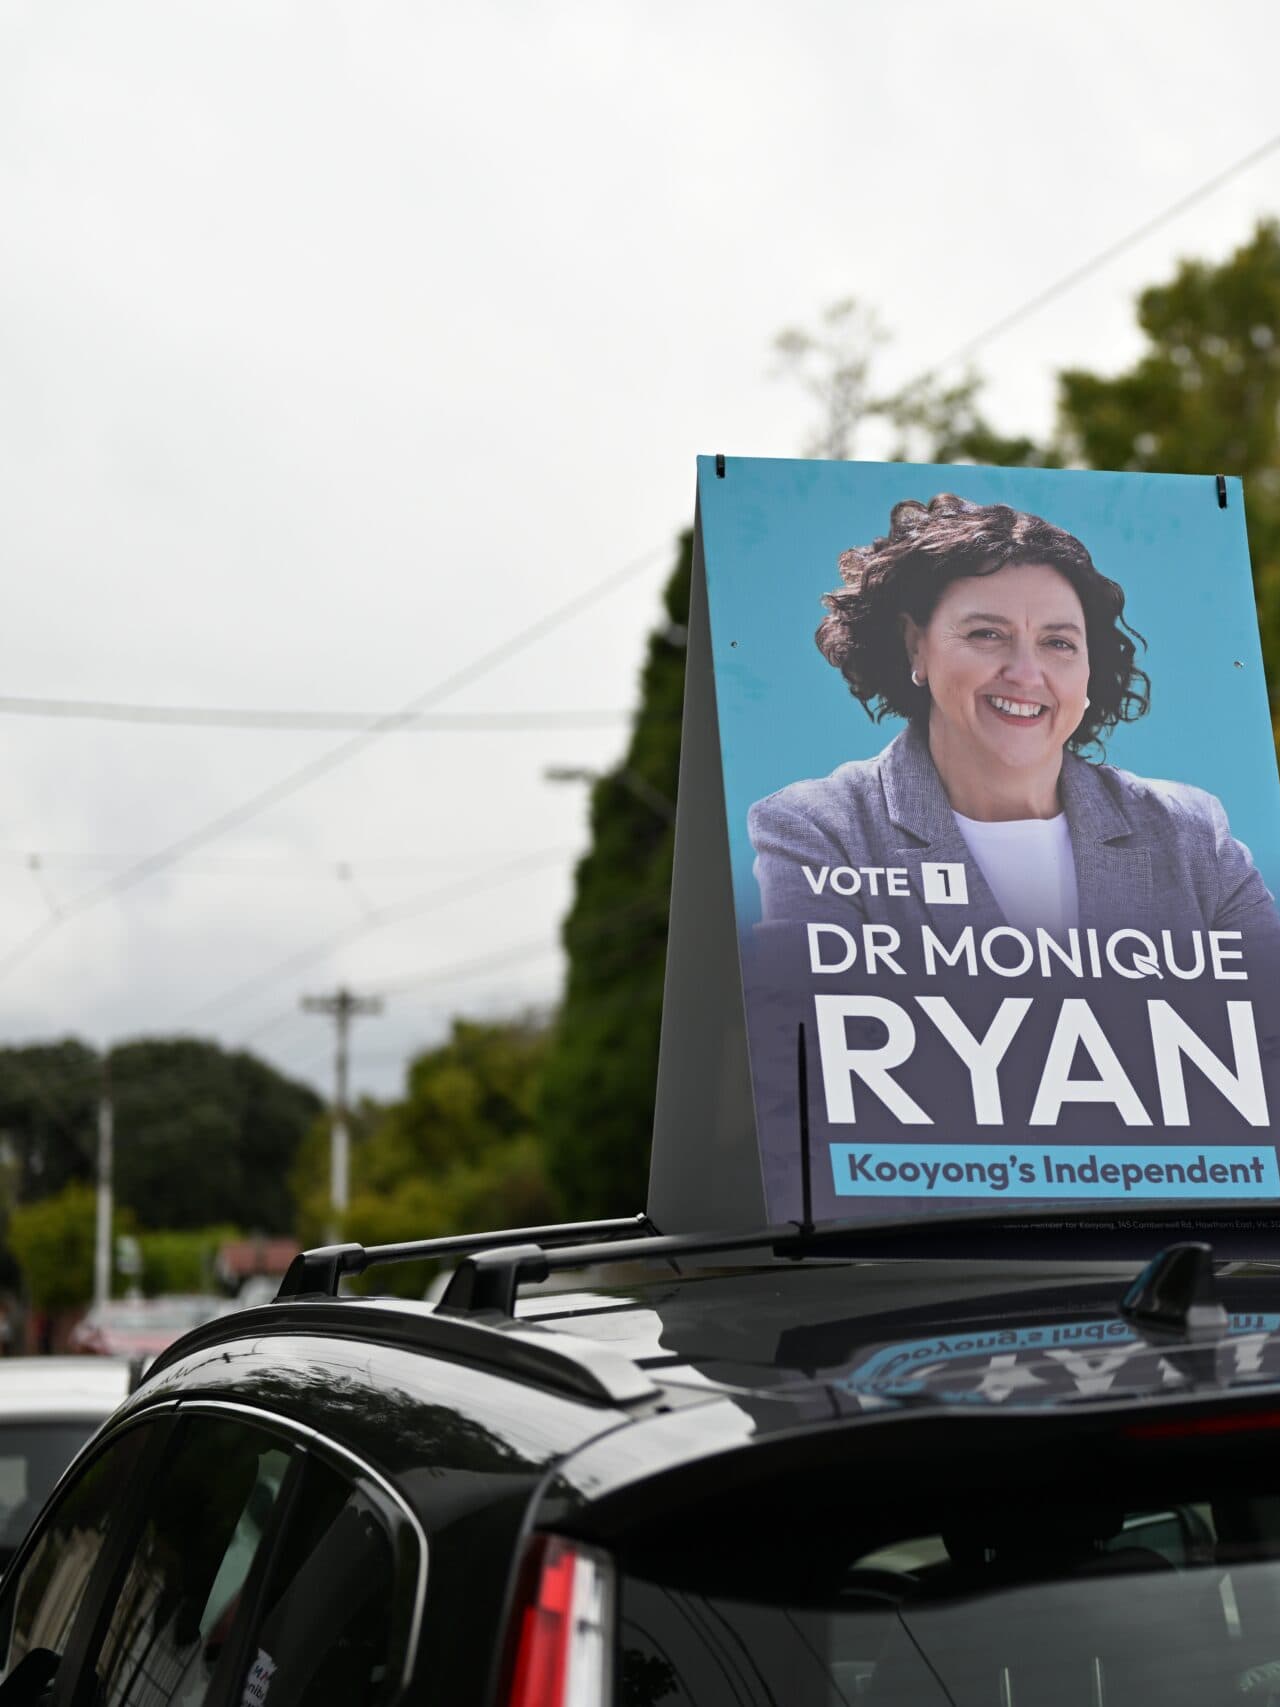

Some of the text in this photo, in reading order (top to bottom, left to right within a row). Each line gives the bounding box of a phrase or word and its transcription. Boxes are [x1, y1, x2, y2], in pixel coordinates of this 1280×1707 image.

[801, 865, 952, 897] VOTE 1
[807, 922, 1248, 980] DR MONIQUE
[815, 994, 1270, 1127] RYAN
[847, 1153, 1265, 1191] Kooyong’s Independent
